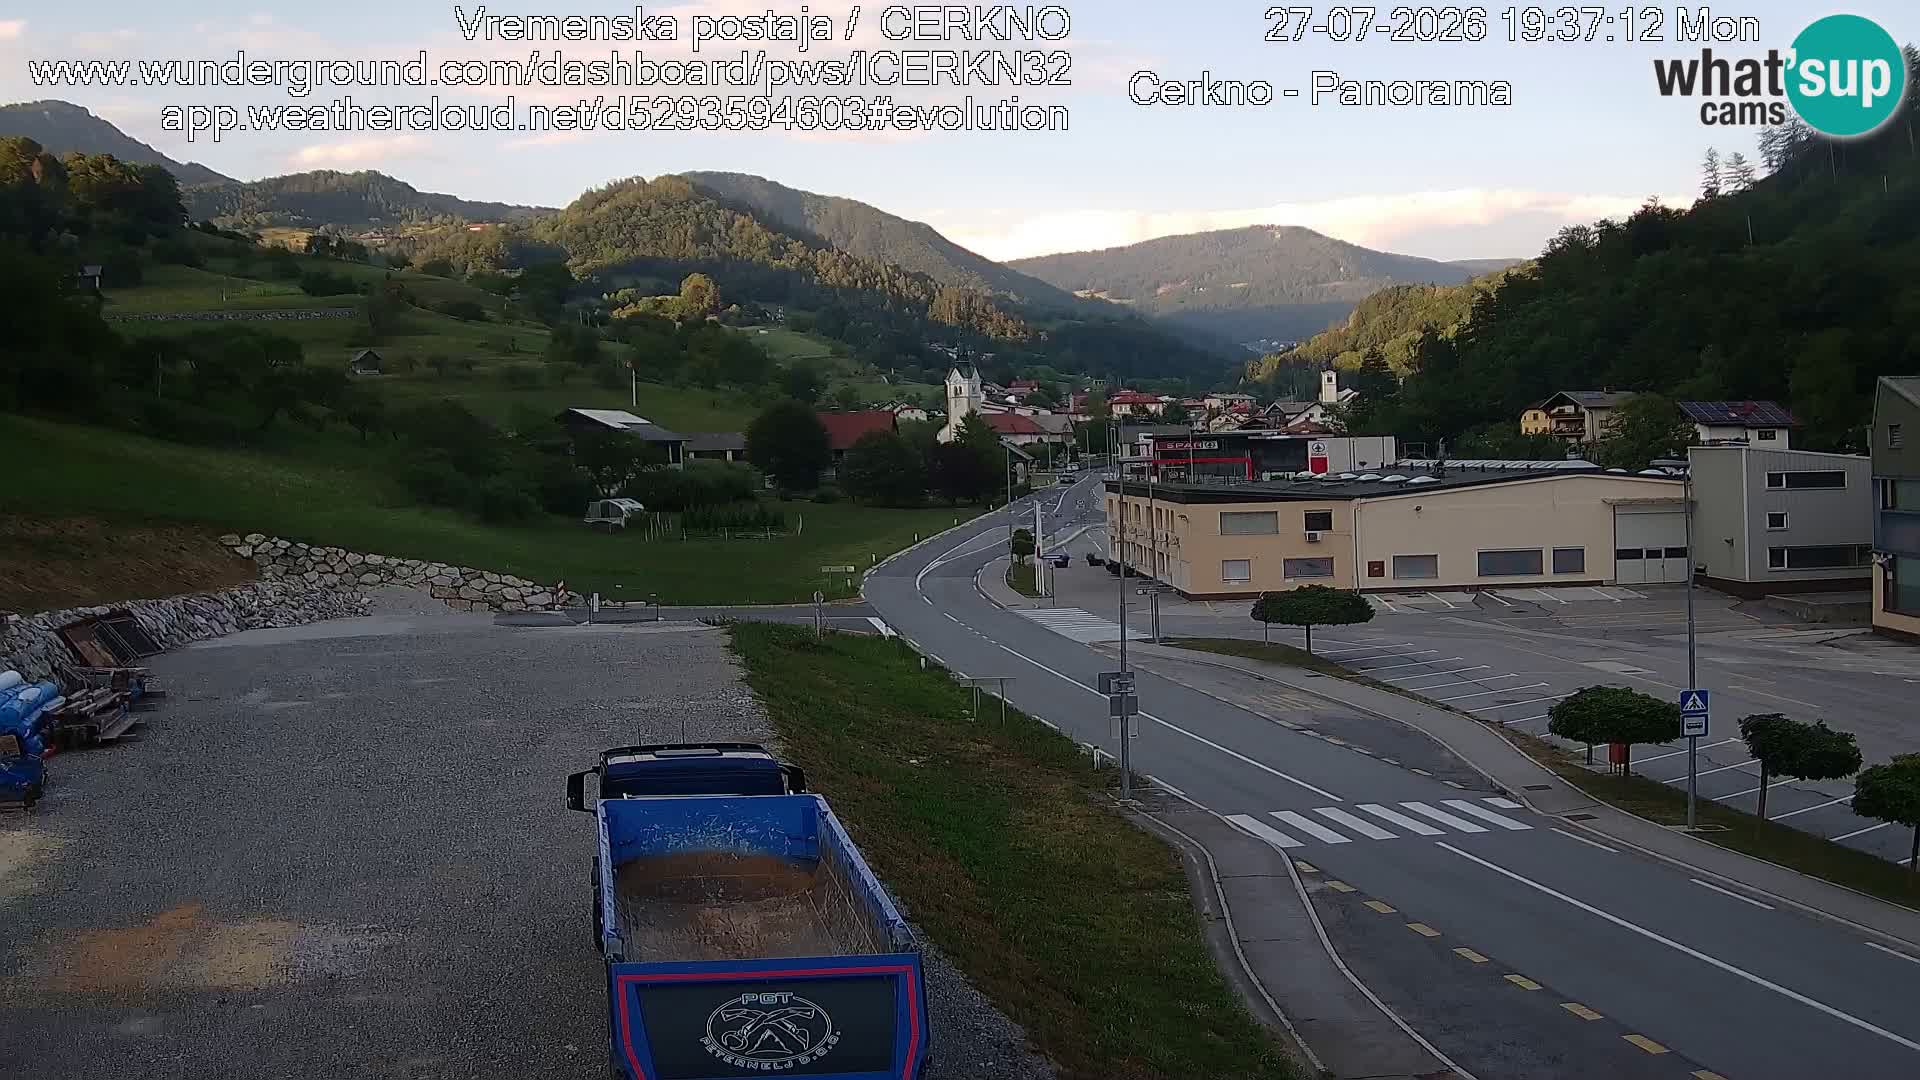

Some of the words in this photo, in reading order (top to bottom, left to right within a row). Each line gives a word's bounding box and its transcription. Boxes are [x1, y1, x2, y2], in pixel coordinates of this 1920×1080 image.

[1166, 442, 1202, 450] SPAR
[741, 992, 794, 1005] PGT
[700, 1036, 794, 1070] PETERNELJ
